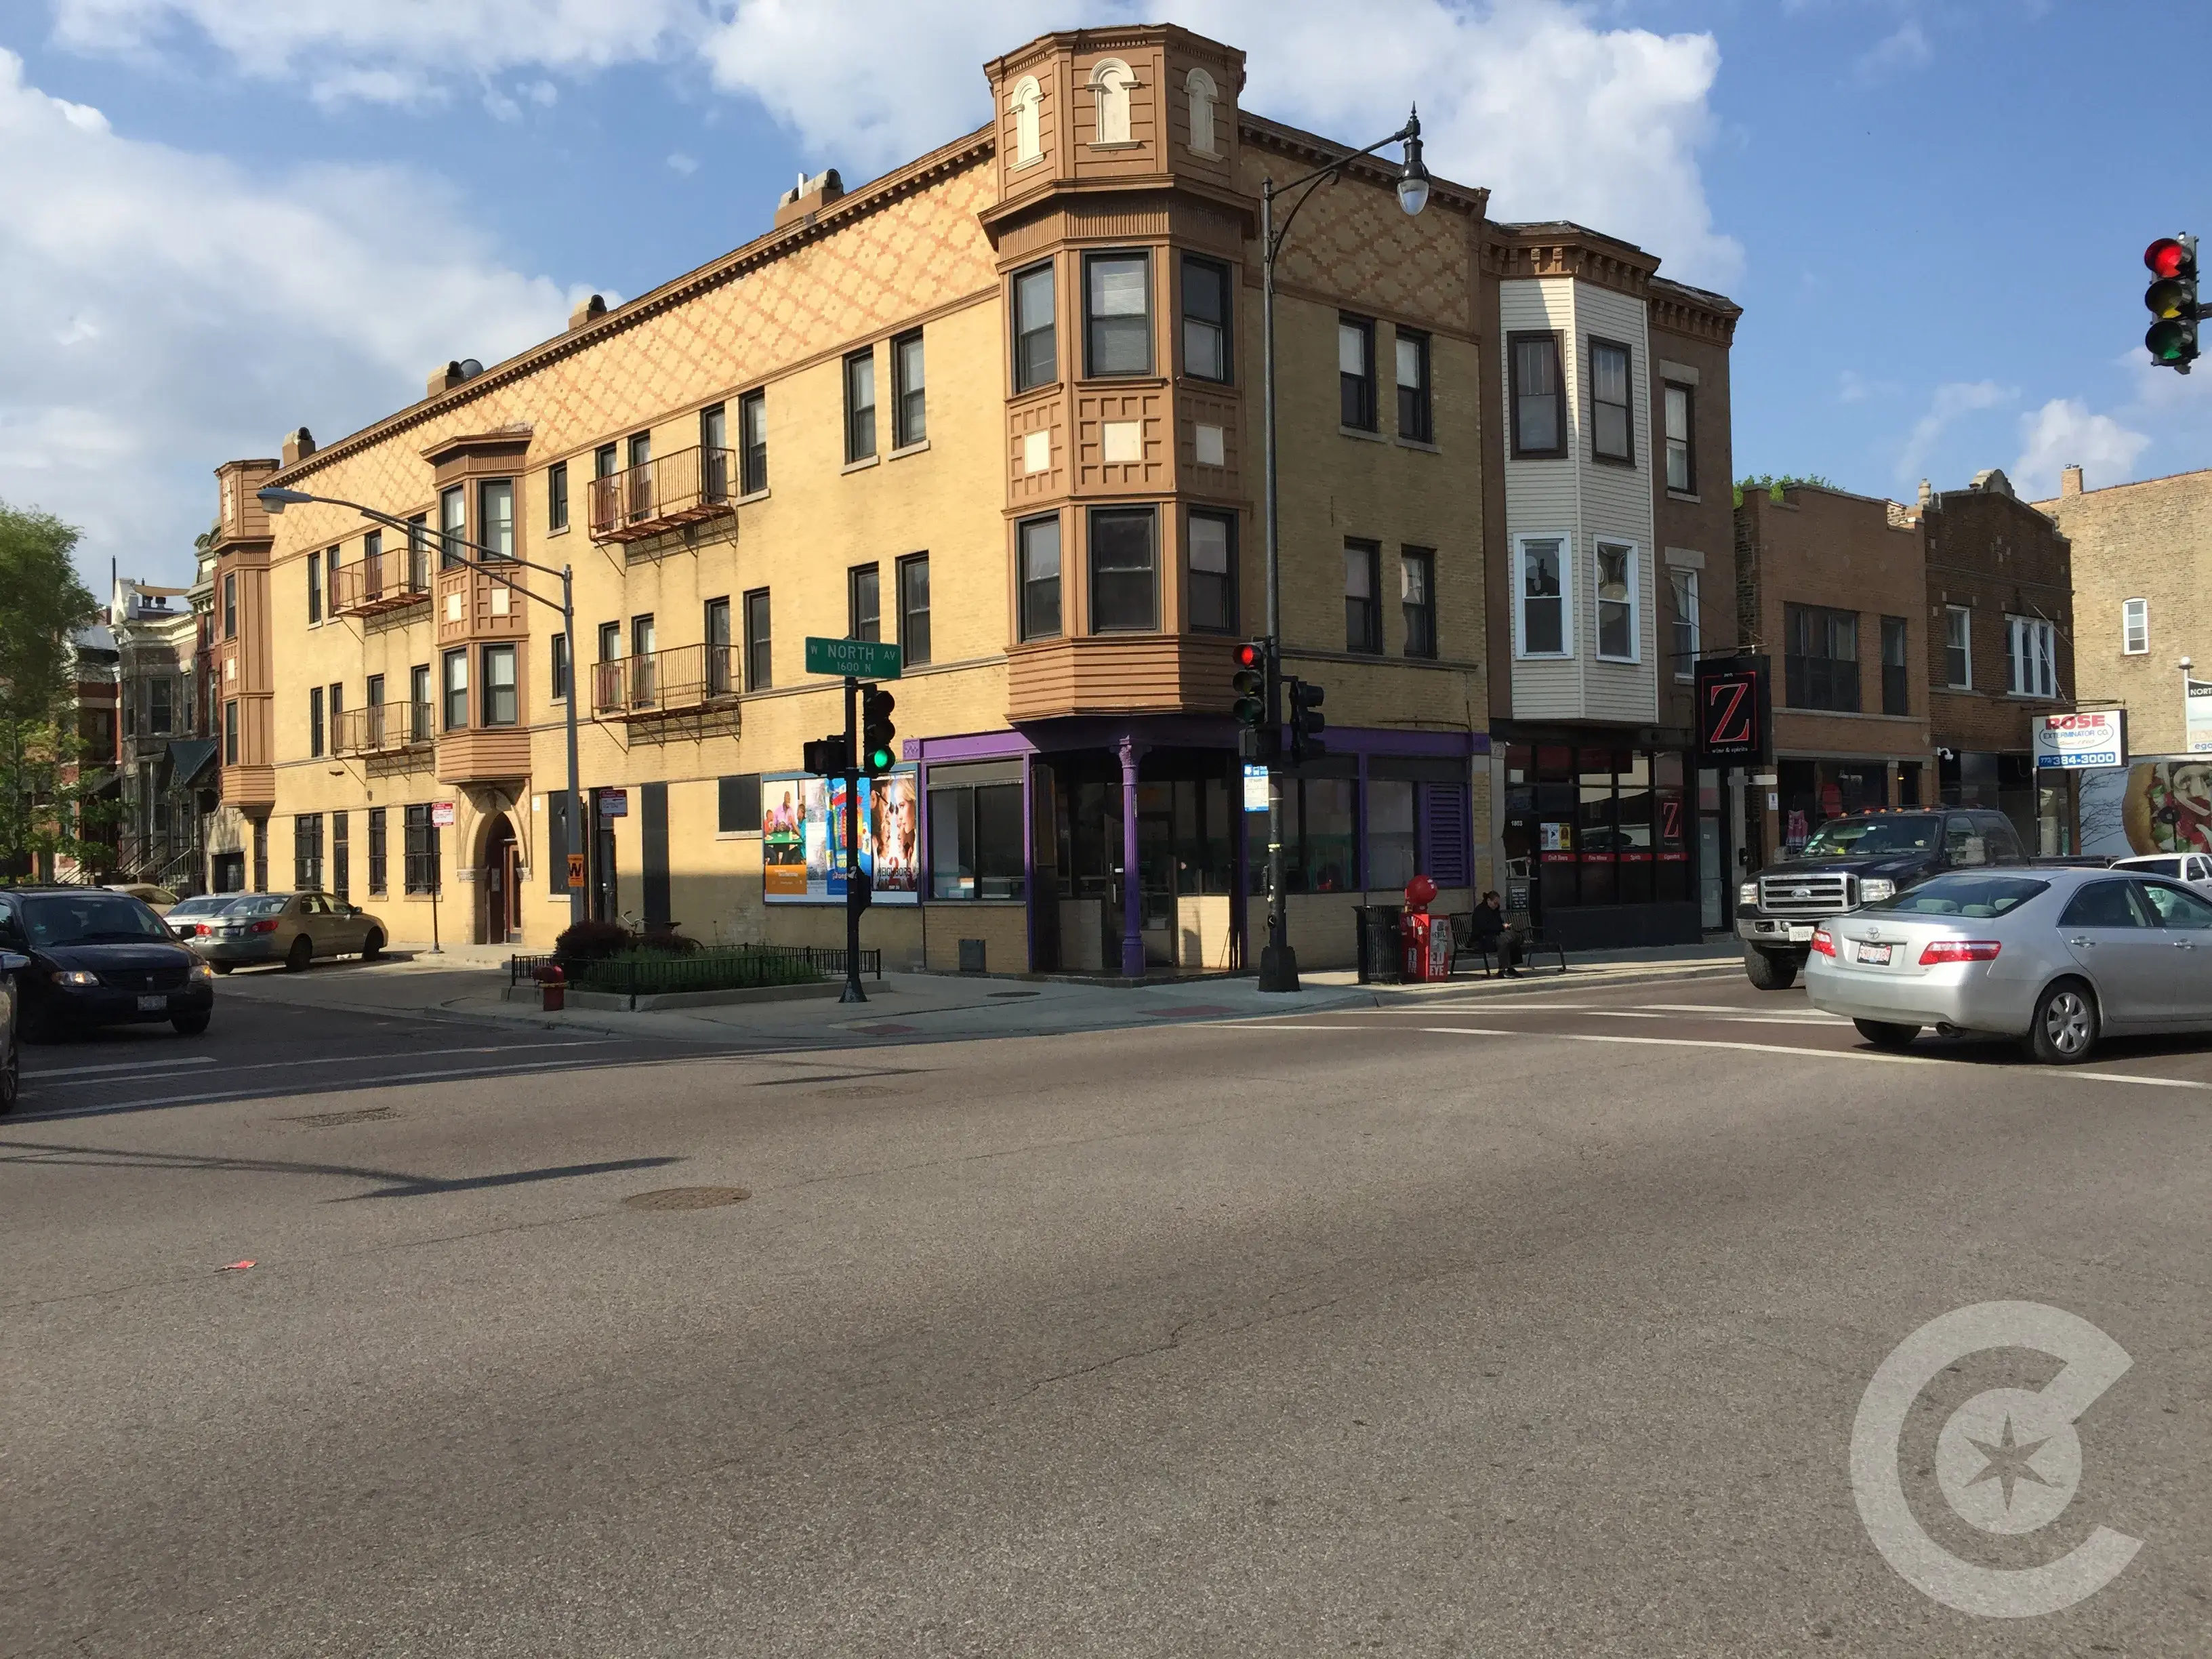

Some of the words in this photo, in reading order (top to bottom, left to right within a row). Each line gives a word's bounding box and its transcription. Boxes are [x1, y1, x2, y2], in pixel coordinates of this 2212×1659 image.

[811, 645, 818, 655] W
[827, 644, 874, 661] NORTH
[883, 651, 896, 660] AV
[837, 661, 859, 672] 1600
[865, 664, 872, 673] N
[2190, 688, 2212, 696] NORT
[1710, 682, 1750, 743] Z
[2045, 715, 2106, 730] ROSE
[2043, 730, 2095, 739] EXTERMINATOR
[1663, 802, 1679, 838] Z
[1429, 965, 1445, 976] EYE
